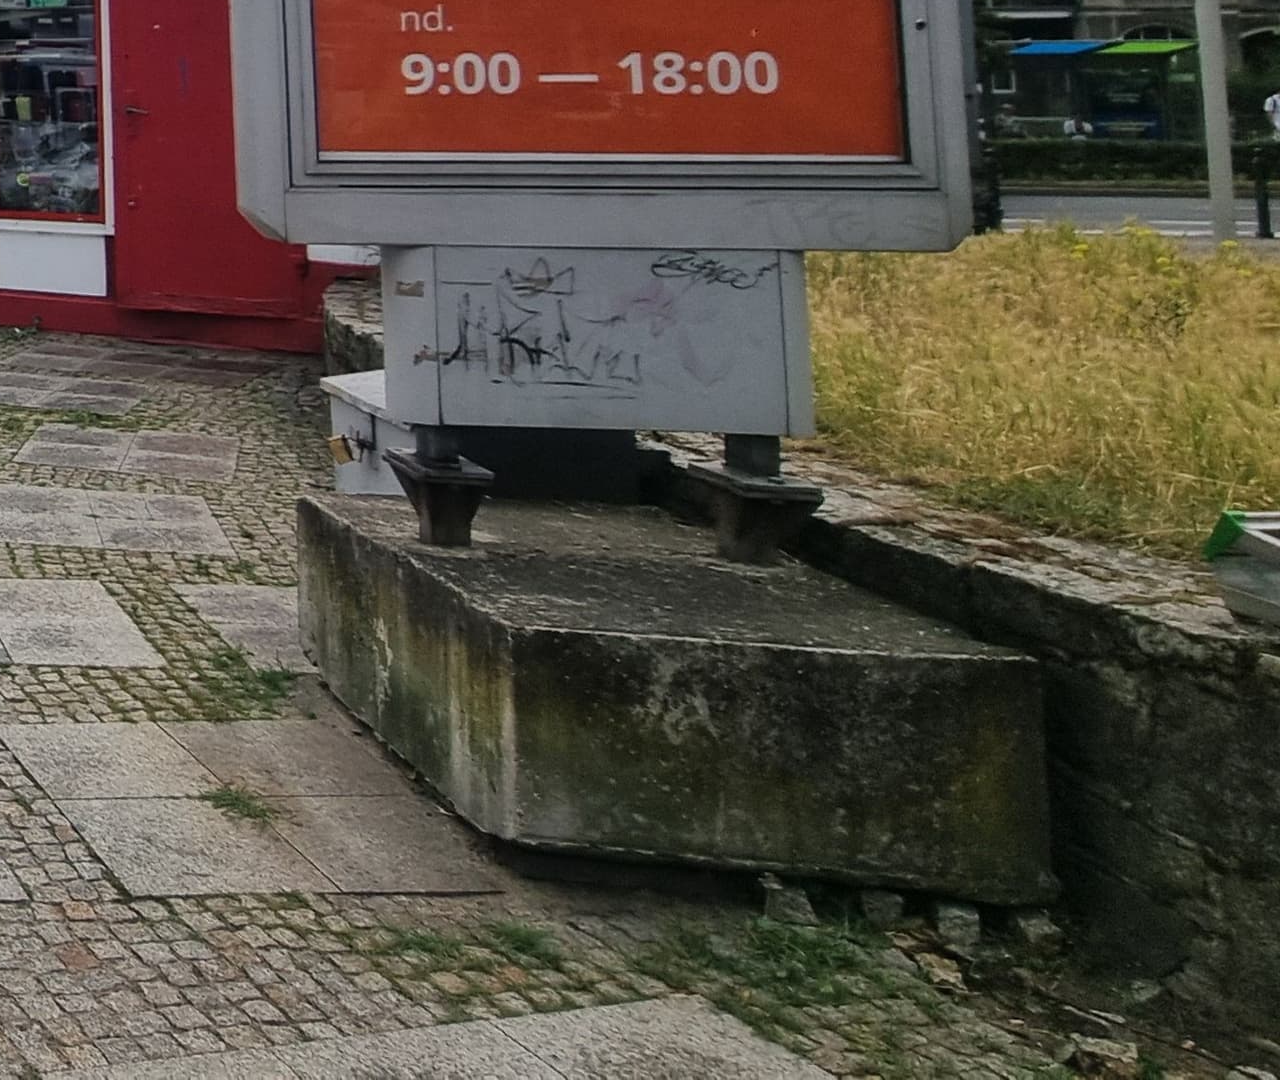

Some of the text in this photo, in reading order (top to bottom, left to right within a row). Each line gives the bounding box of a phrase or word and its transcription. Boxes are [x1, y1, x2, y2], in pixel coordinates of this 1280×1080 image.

[398, 3, 455, 33] nd.
[400, 51, 522, 96] 9:00
[616, 50, 780, 96] 18:00
